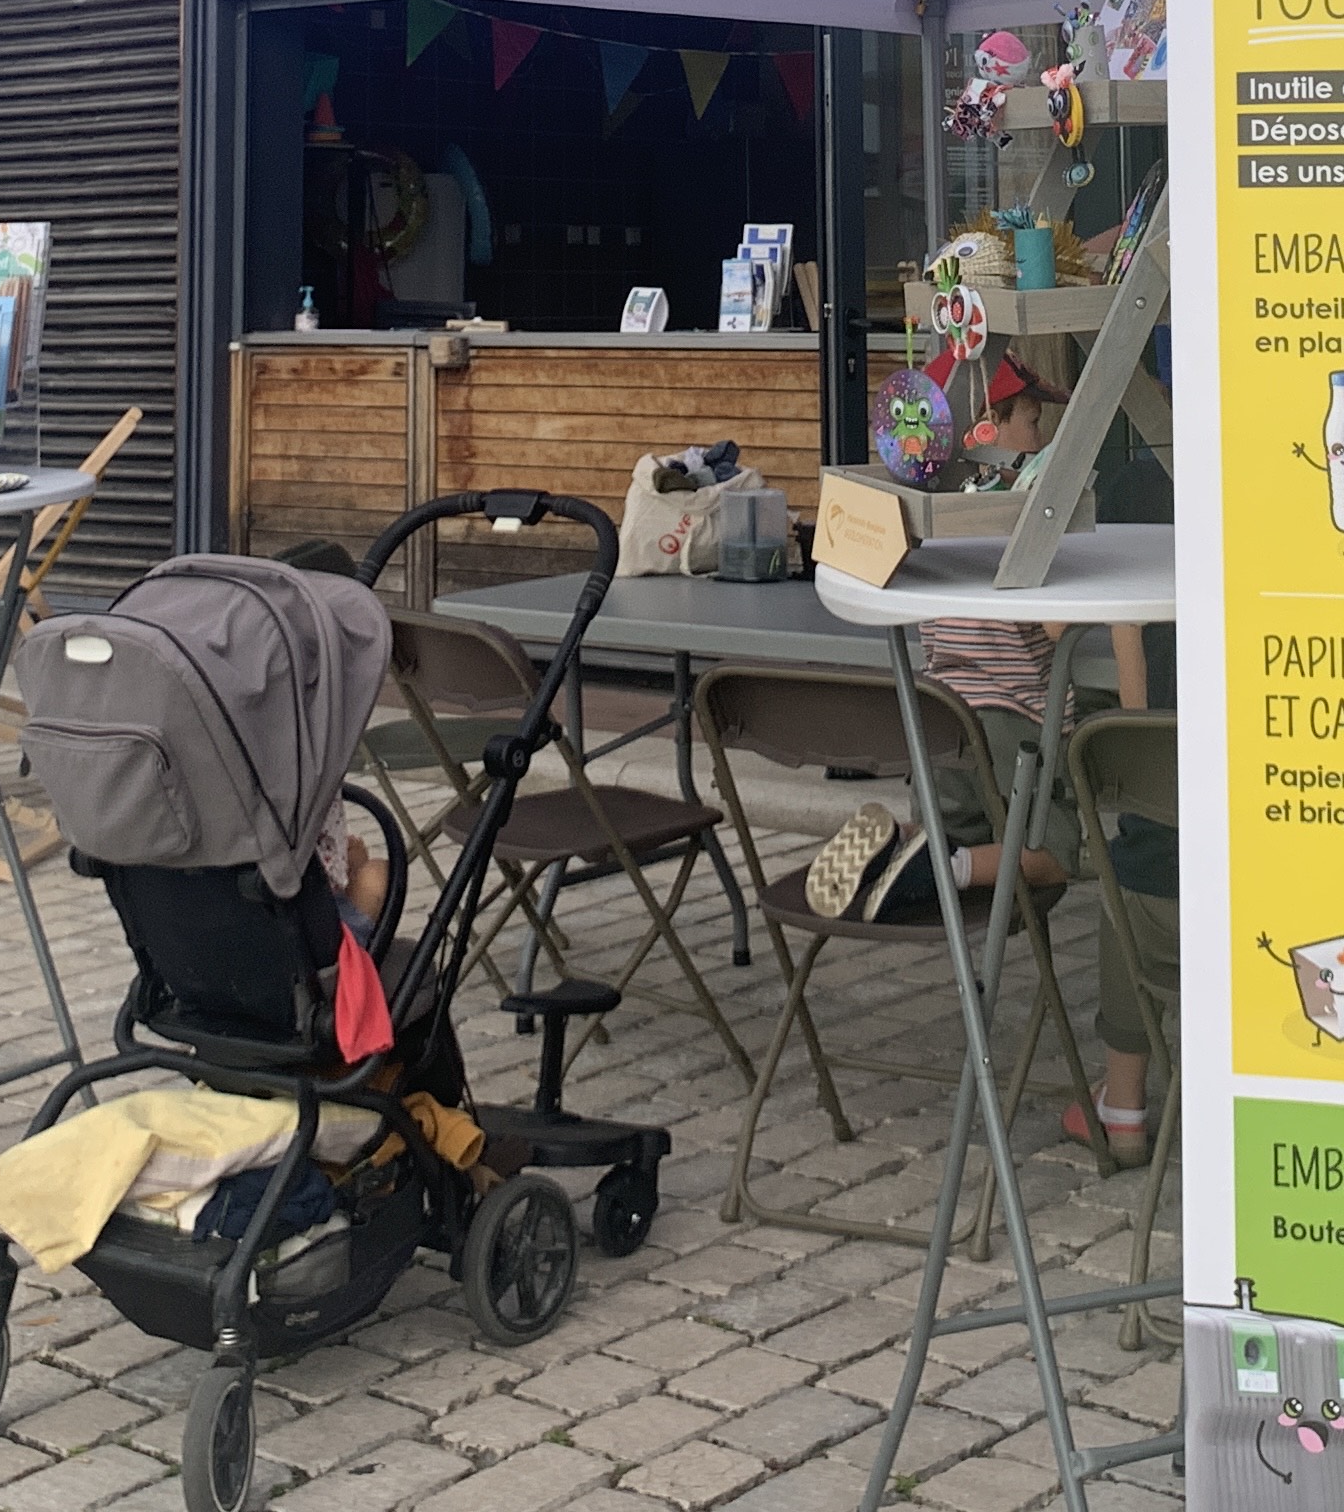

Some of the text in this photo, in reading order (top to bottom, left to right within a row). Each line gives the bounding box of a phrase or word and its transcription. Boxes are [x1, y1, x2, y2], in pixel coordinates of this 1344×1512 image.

[1250, 77, 1332, 99] Inutile
[1251, 161, 1288, 182] les
[1299, 166, 1344, 182] uns
[1256, 337, 1288, 352] en
[1266, 695, 1300, 737] ET
[1266, 800, 1291, 821] et
